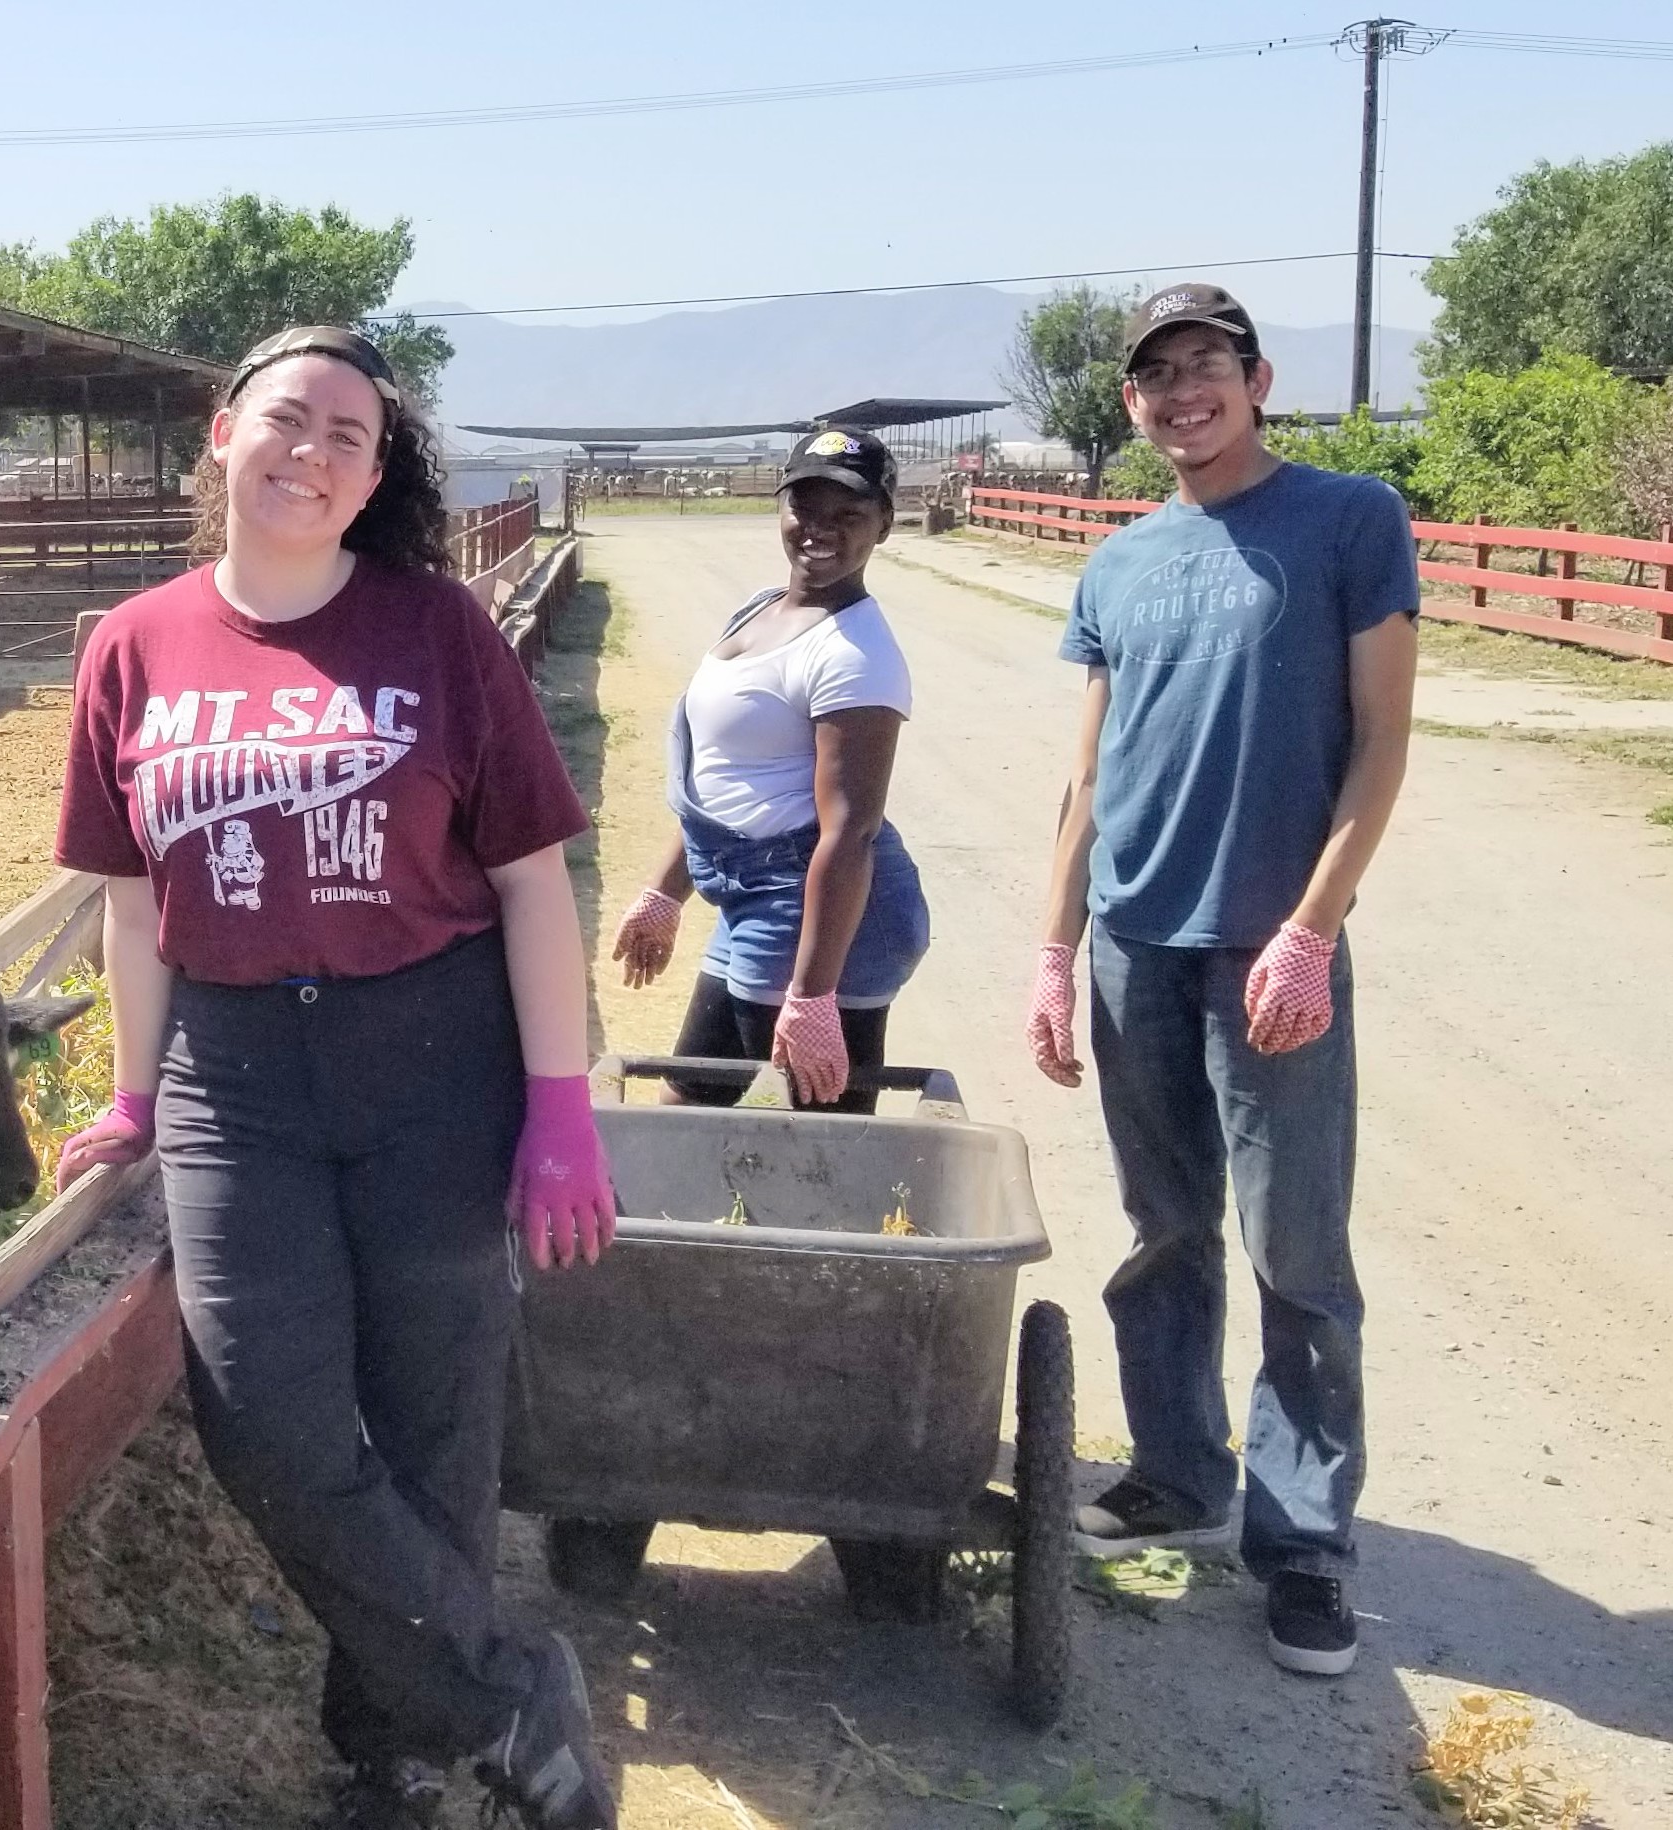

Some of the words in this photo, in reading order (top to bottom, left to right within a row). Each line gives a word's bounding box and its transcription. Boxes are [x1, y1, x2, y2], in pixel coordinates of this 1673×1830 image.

[303, 799, 388, 881] 1946
[310, 886, 392, 904] FOUNDED
[29, 1037, 51, 1060] 69
